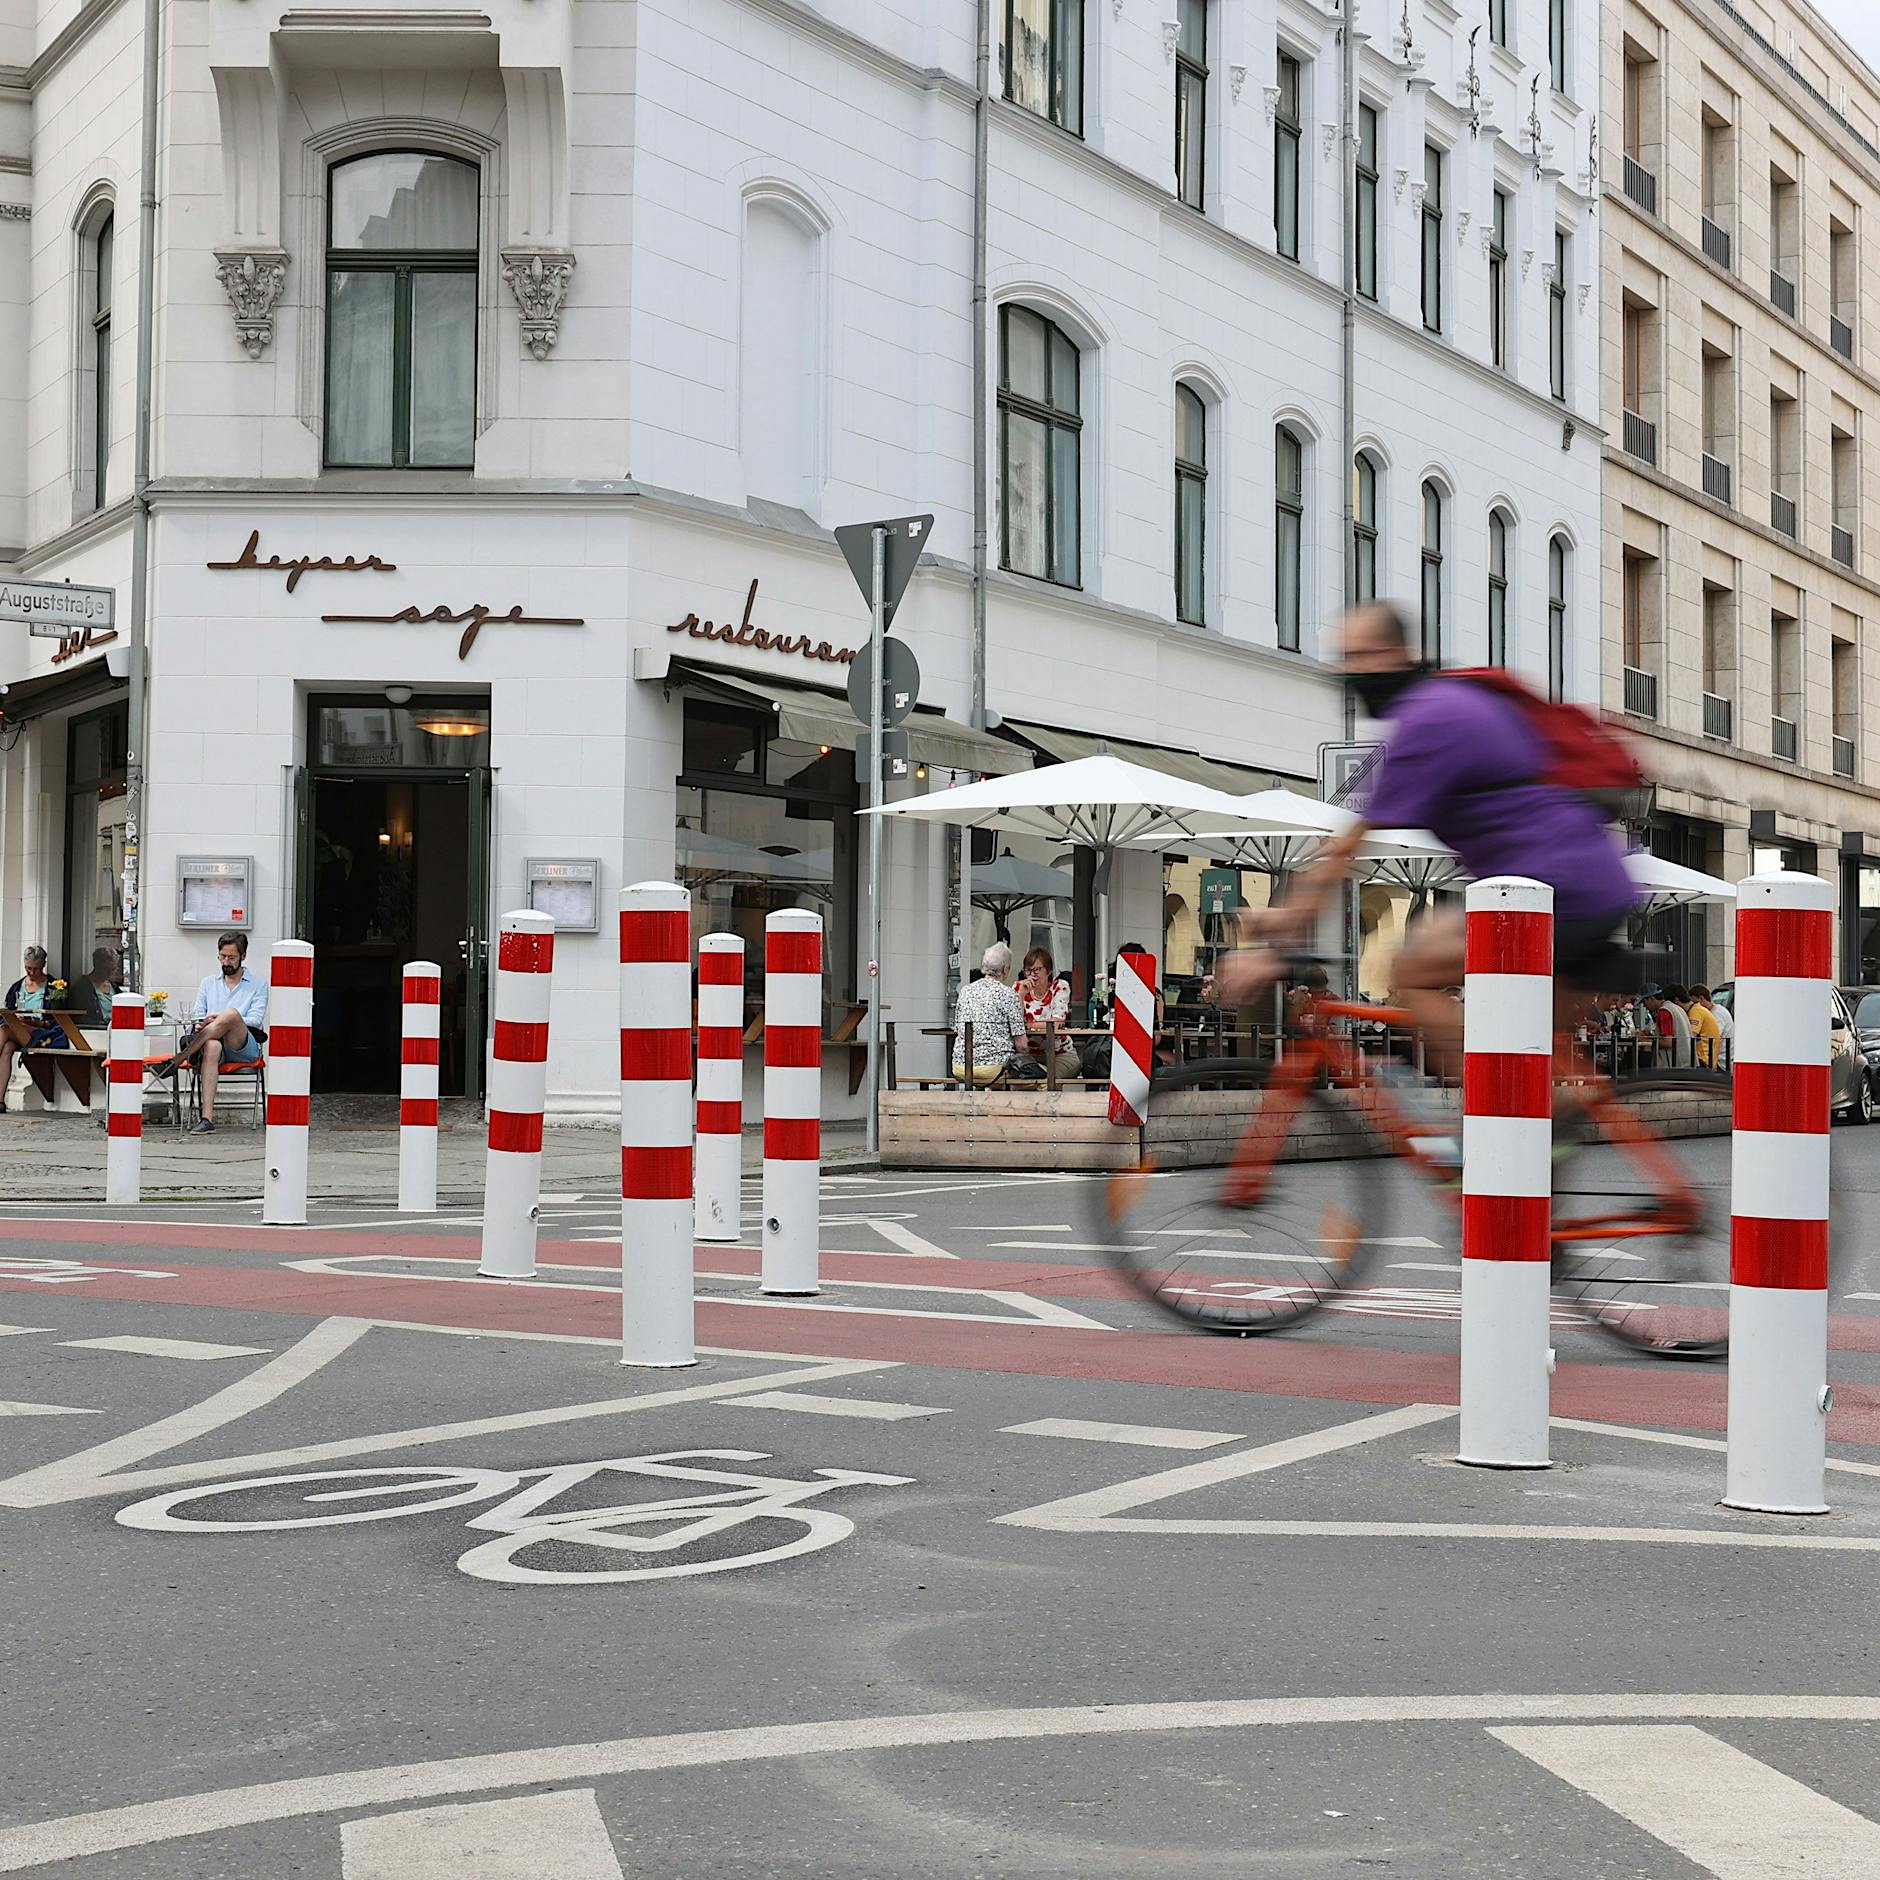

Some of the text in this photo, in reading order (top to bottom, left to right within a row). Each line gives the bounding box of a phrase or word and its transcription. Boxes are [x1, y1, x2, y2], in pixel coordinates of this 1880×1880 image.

[207, 530, 397, 593] keyser
[0, 586, 104, 618] Auguststraße
[667, 578, 858, 663] restauran
